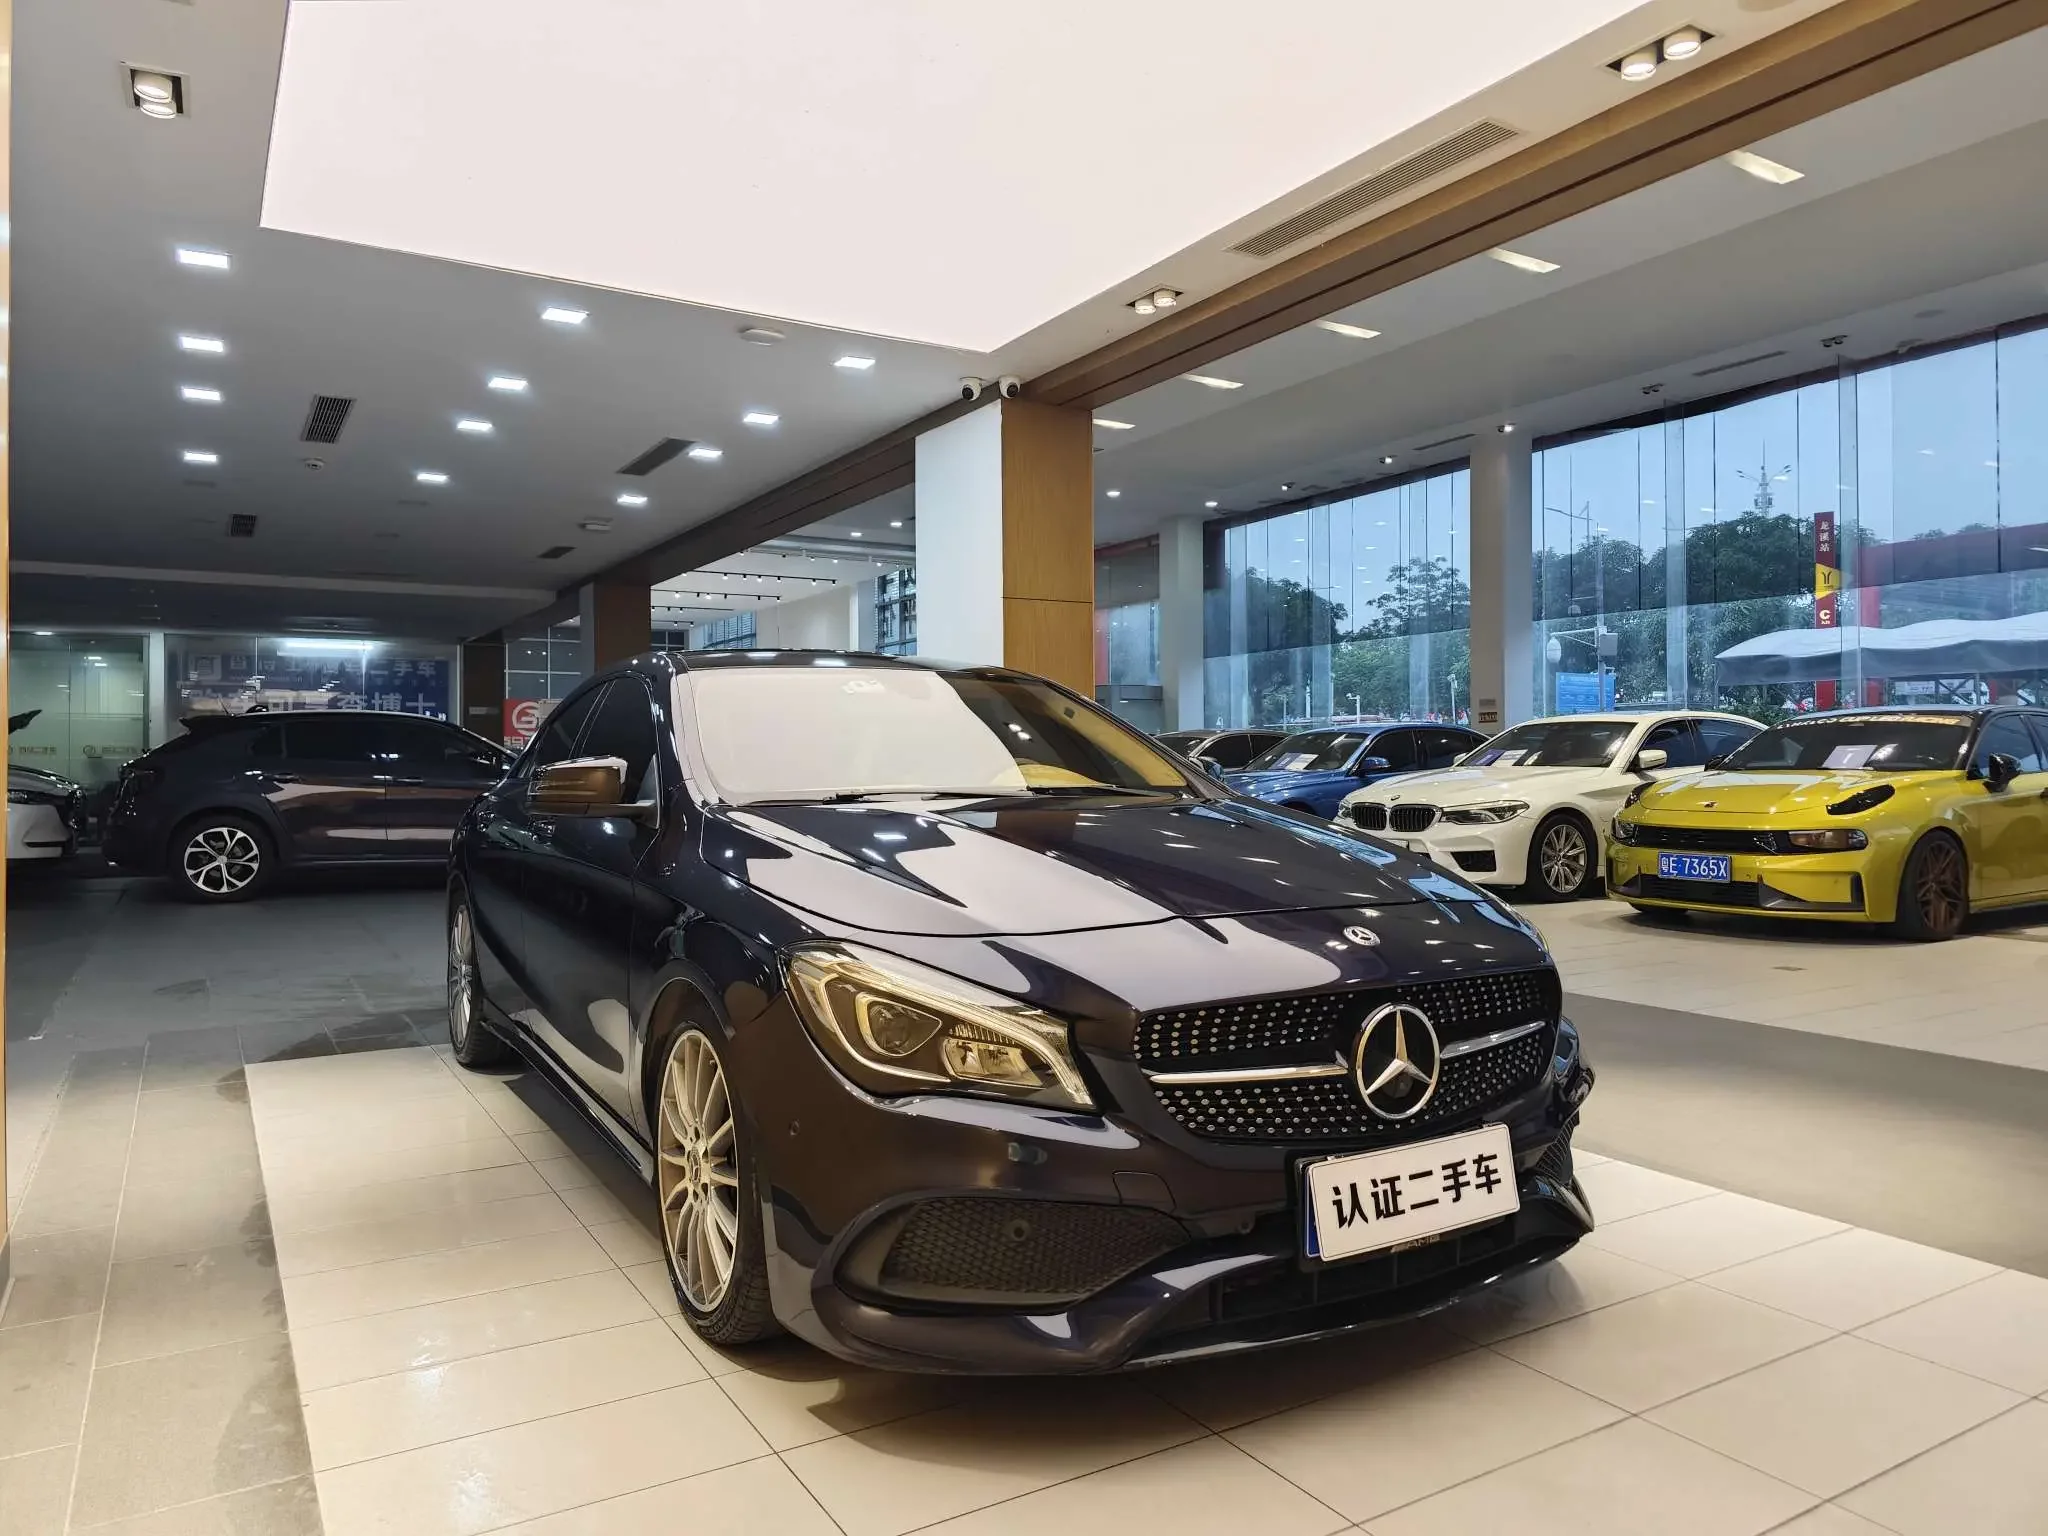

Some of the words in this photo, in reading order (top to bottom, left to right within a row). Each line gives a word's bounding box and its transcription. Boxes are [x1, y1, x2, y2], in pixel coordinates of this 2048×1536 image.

[1819, 609, 1832, 620] C
[1332, 1153, 1502, 1229] 认证二手车
